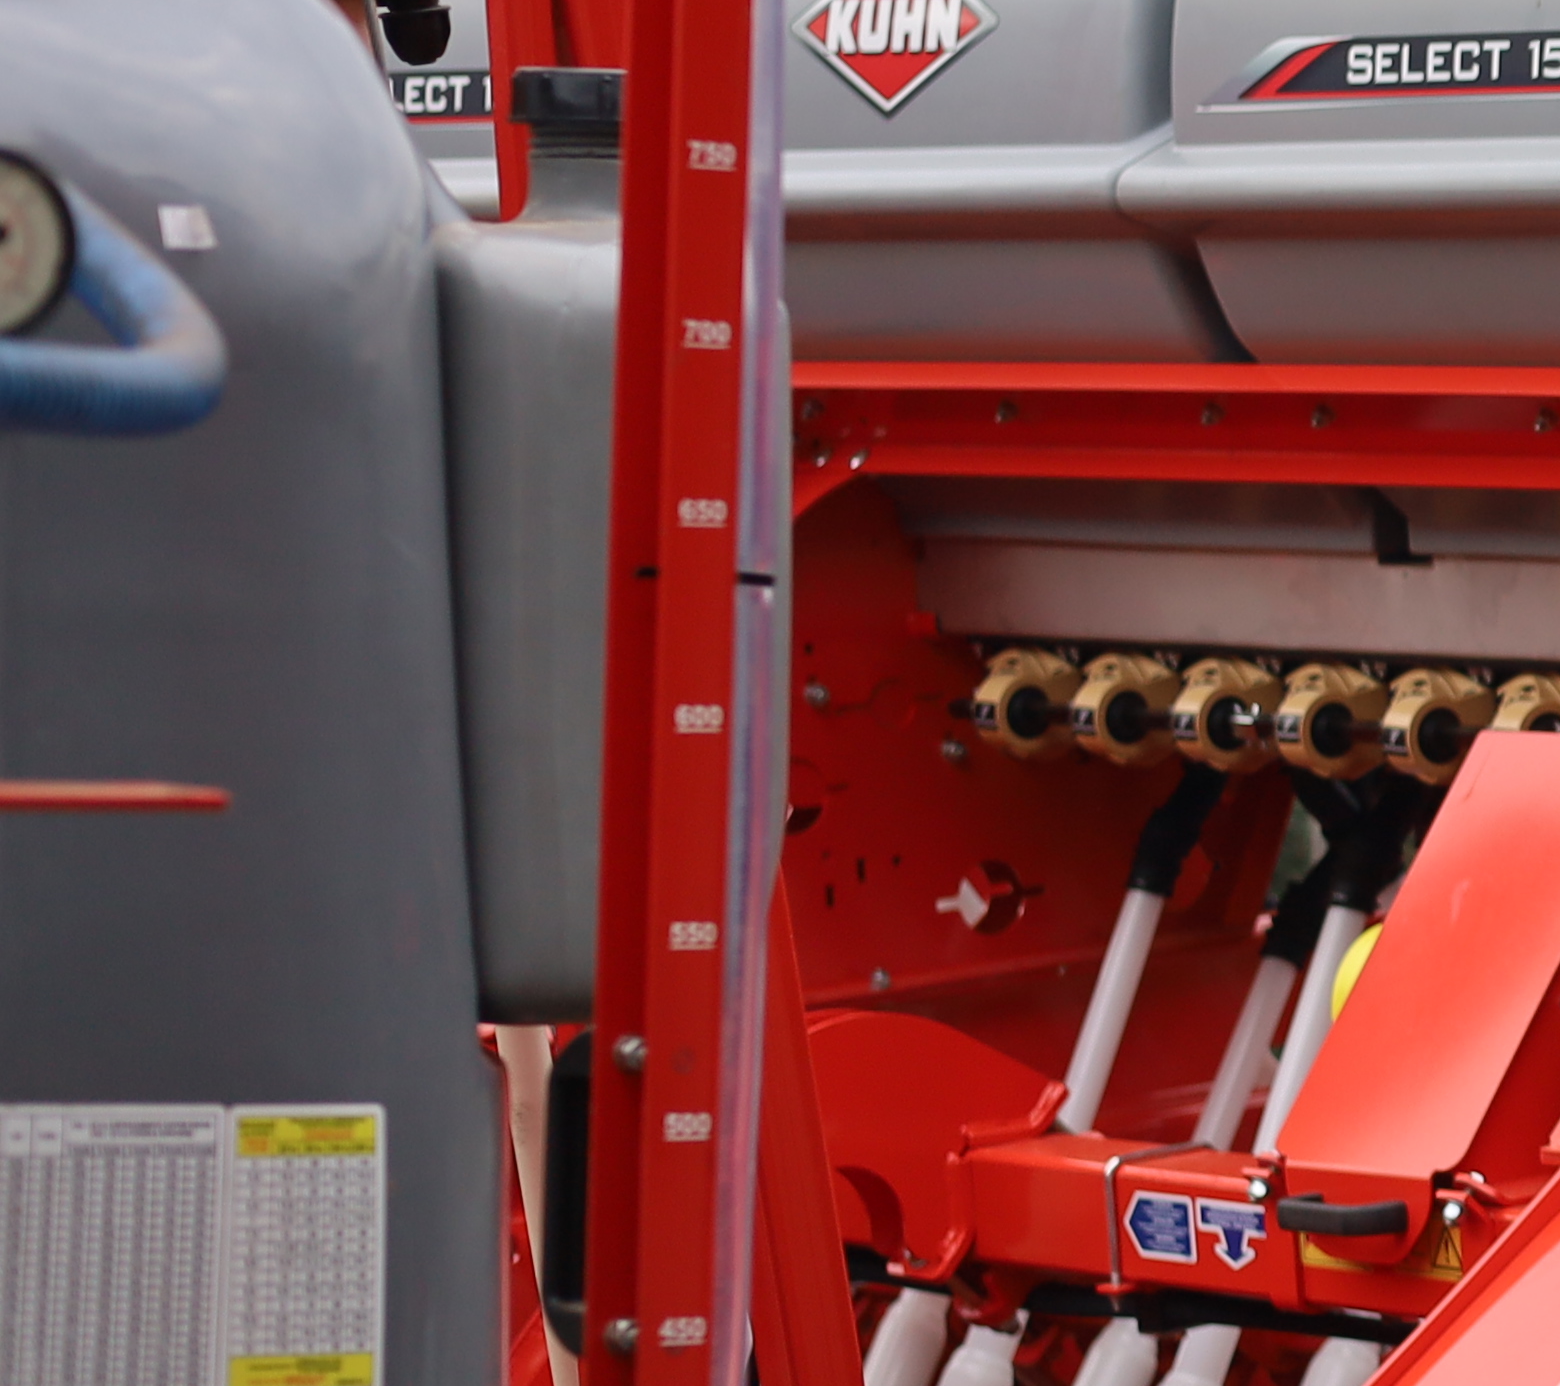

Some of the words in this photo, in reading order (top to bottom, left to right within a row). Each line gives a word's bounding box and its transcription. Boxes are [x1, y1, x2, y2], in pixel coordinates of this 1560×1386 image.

[1345, 40, 1512, 87] SELECT
[388, 74, 472, 113] LECT
[688, 140, 737, 168] 750
[684, 319, 732, 346] 700
[678, 498, 728, 524] 650
[674, 704, 724, 730] 600
[669, 921, 718, 947] 550
[664, 1112, 712, 1138] 500
[658, 1316, 707, 1343] 450
